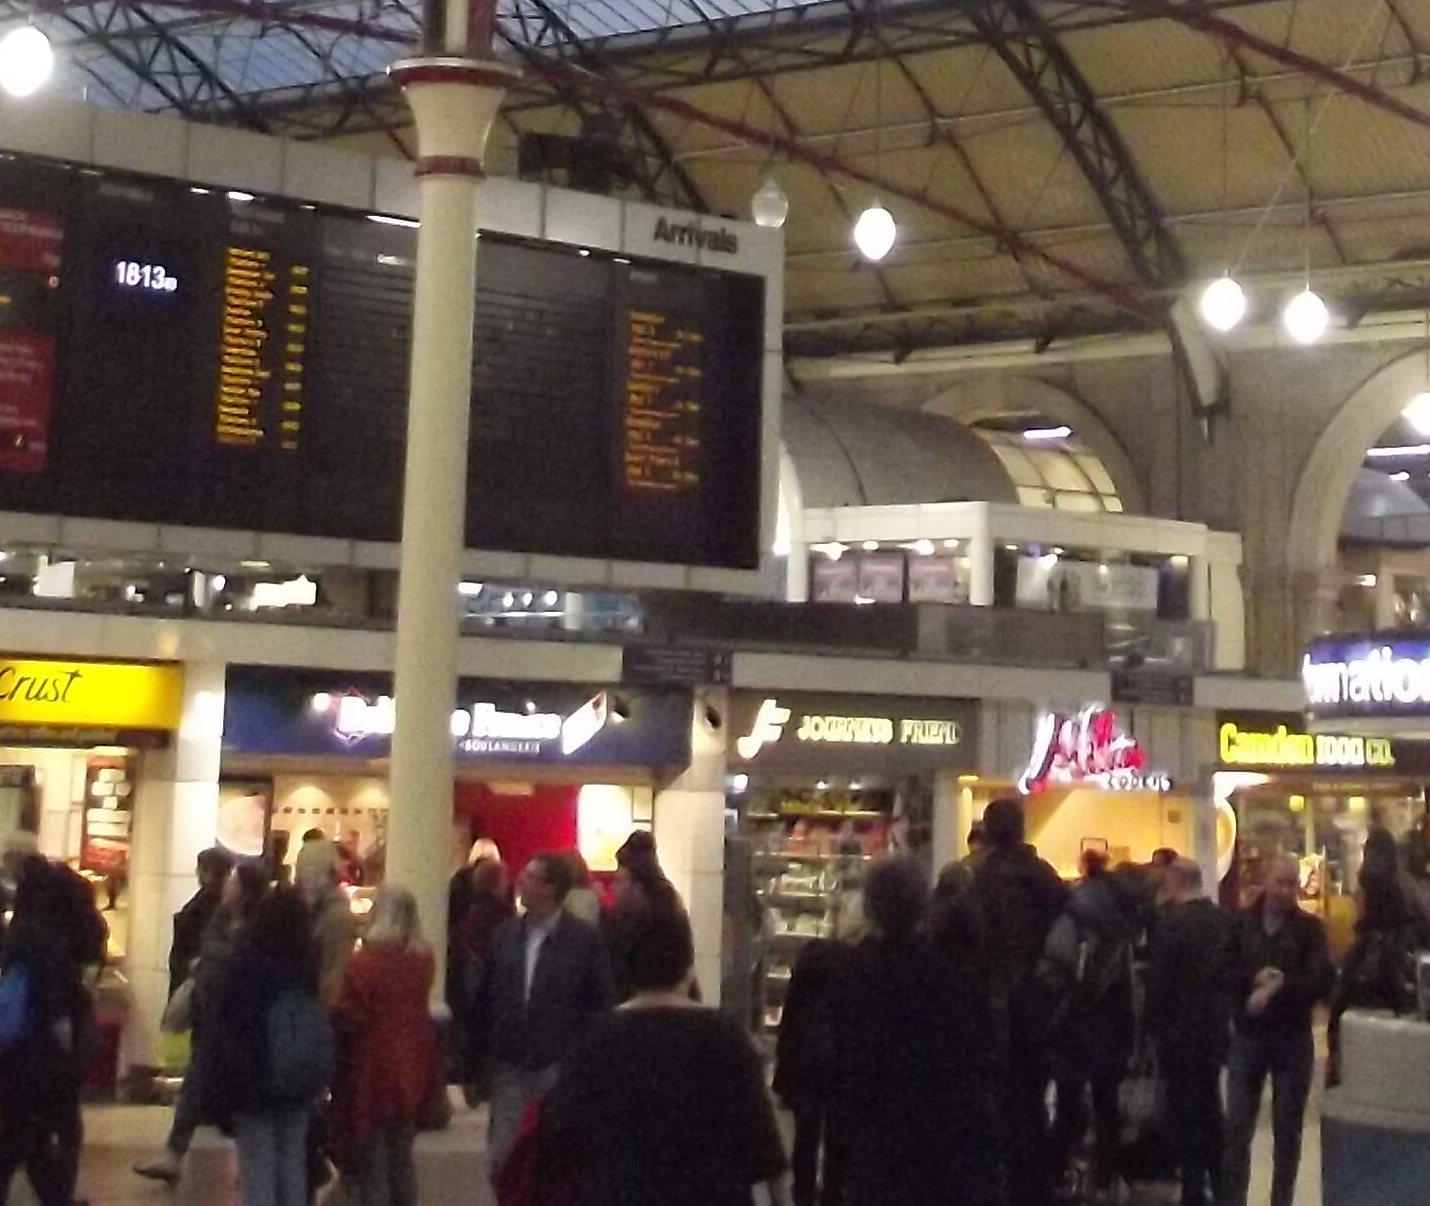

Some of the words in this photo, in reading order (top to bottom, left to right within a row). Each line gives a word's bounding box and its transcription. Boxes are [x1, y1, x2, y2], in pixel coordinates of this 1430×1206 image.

[653, 215, 737, 255] Arrivals
[900, 719, 960, 745] FRIEND
[1220, 723, 1314, 765] Camden
